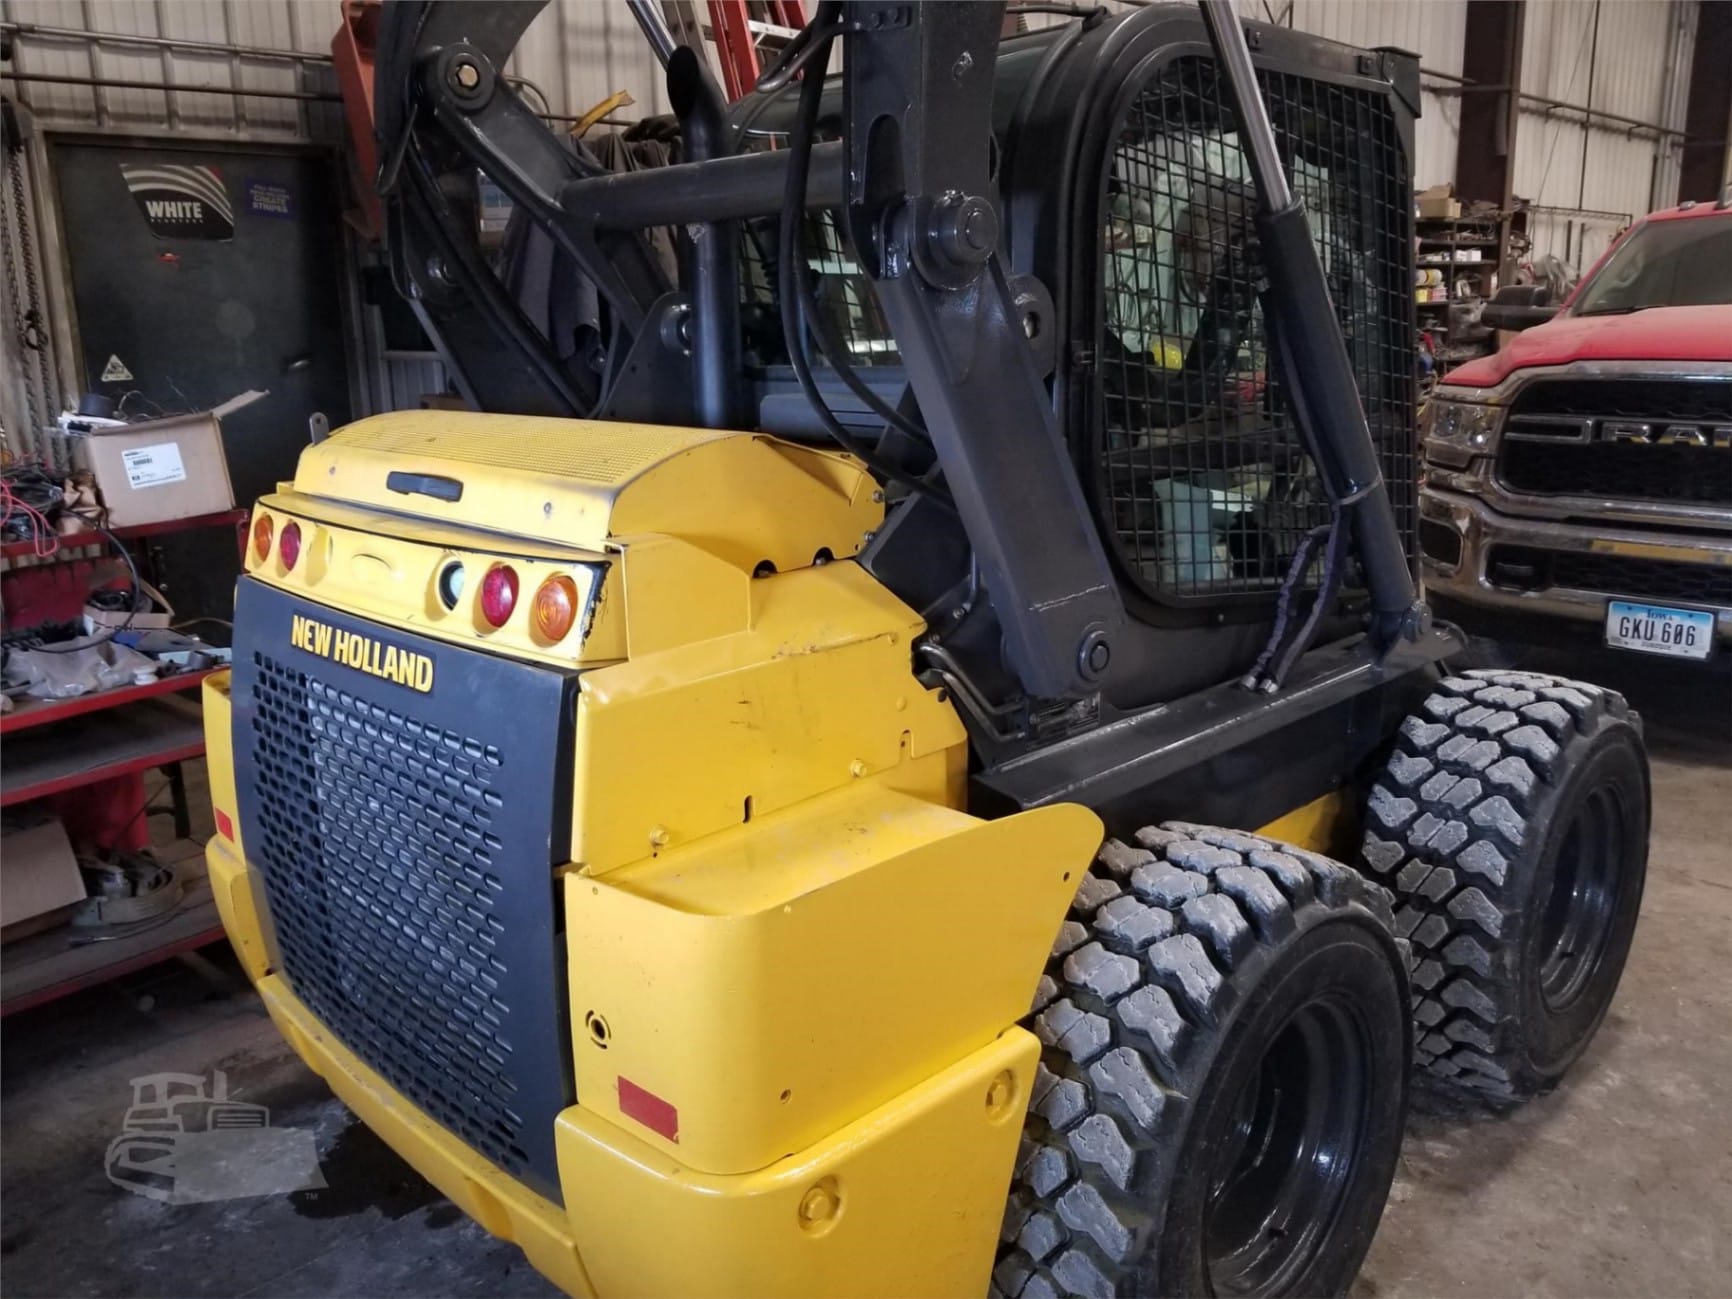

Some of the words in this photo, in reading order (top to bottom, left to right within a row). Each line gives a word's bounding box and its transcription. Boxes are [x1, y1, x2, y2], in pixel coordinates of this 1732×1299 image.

[145, 200, 202, 218] WHITE
[1619, 616, 1655, 641] GKU
[1661, 622, 1696, 647] 606
[291, 614, 332, 658] NEW
[333, 628, 433, 693] HOLLAND
